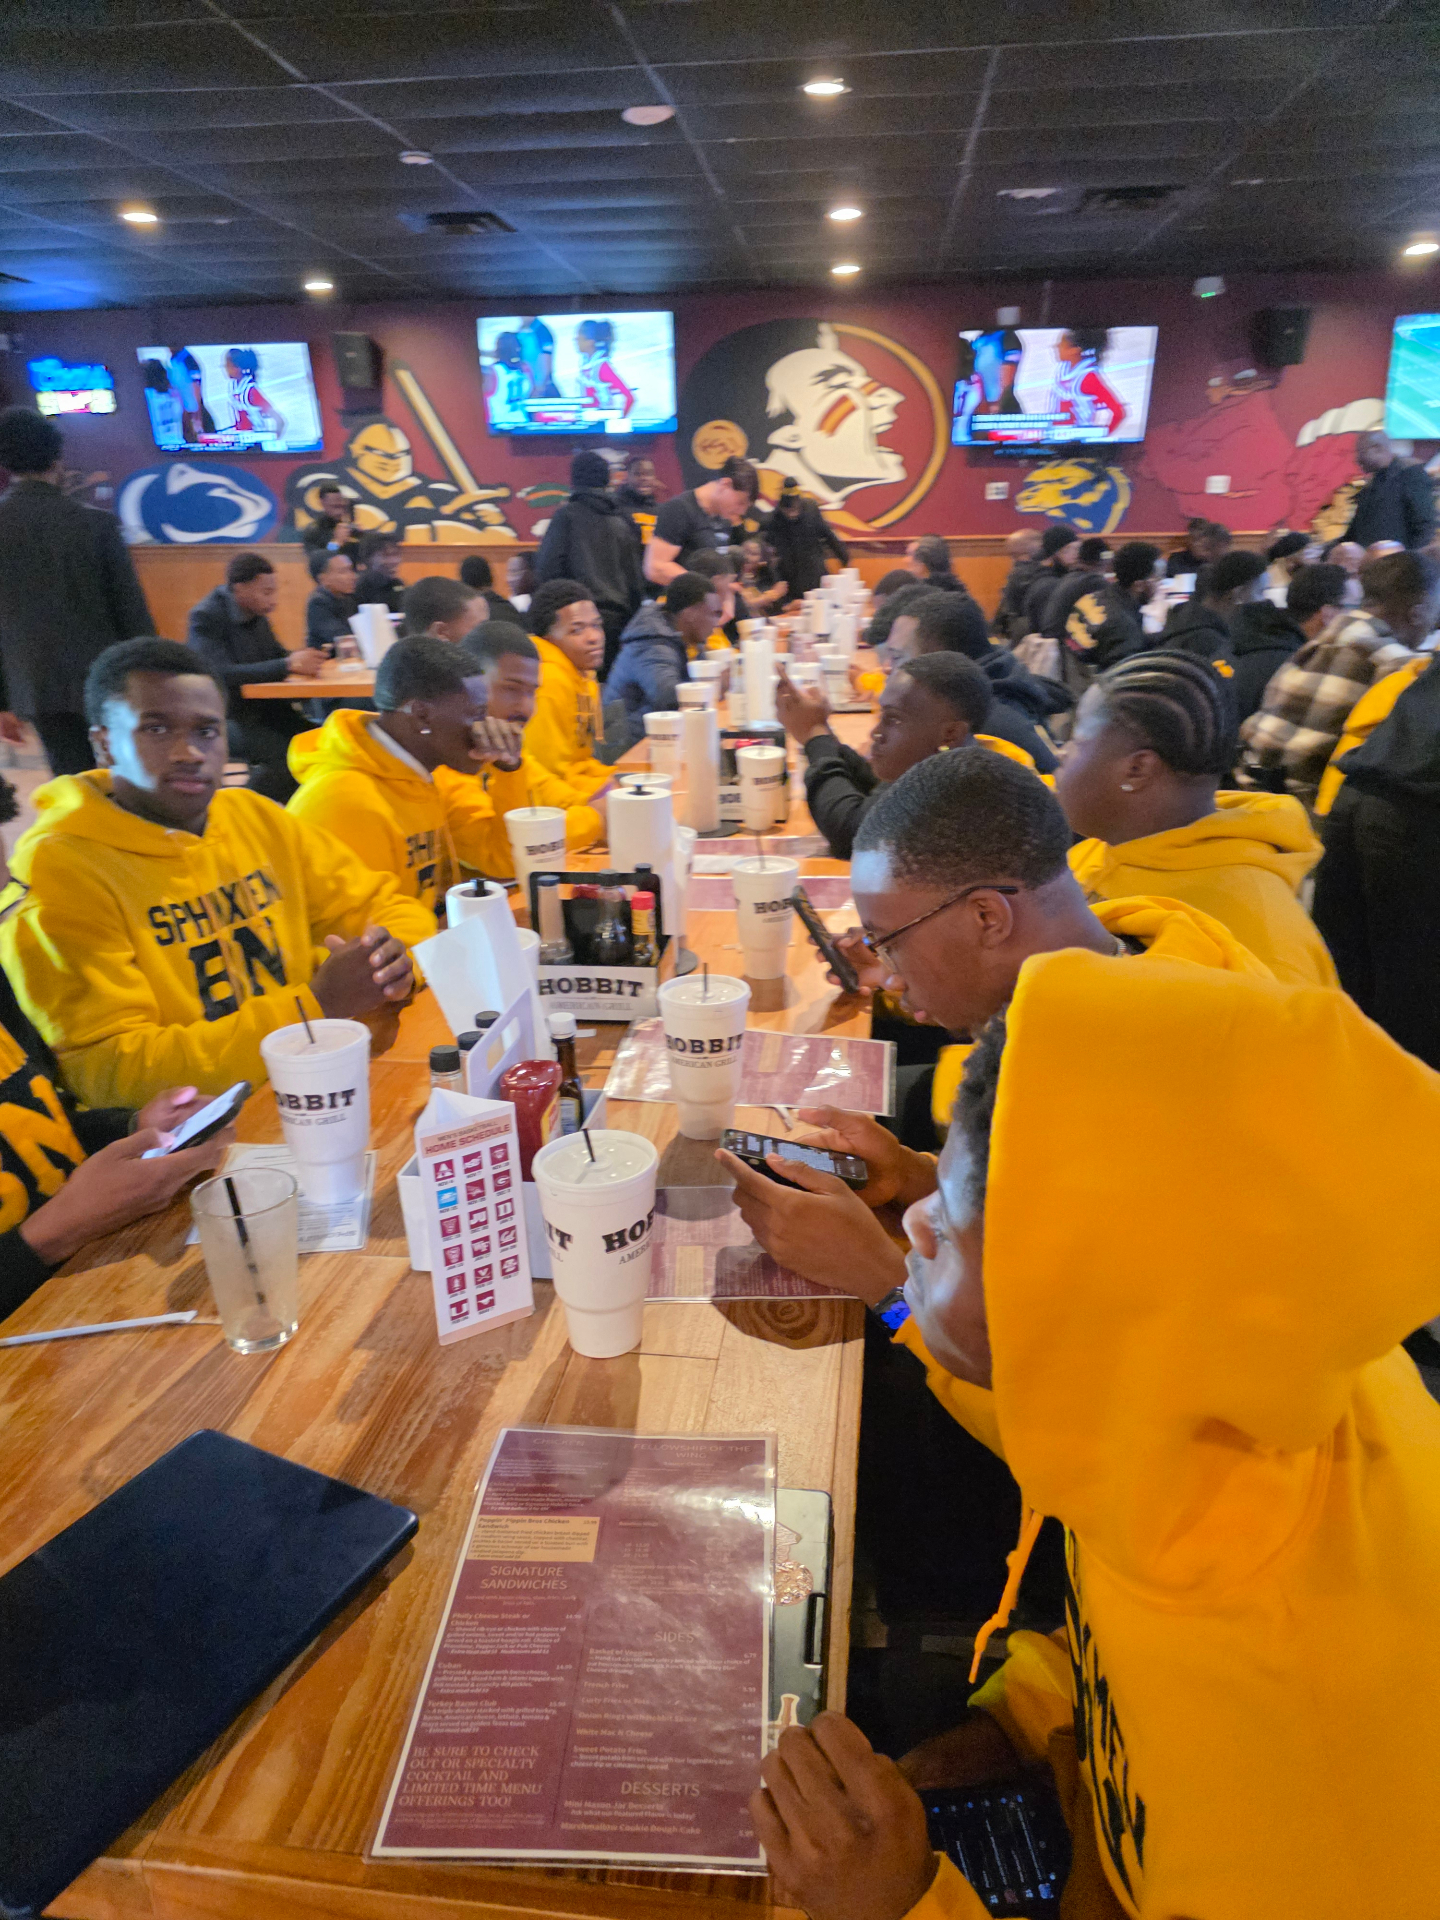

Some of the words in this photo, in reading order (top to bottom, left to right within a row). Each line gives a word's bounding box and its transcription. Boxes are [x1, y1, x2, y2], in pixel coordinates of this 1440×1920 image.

[538, 977, 644, 997] HOBBIT
[274, 1088, 356, 1110] OBBIT
[458, 1121, 498, 1137] BASKETBALL
[425, 1140, 457, 1154] HOME
[459, 1123, 510, 1146] SCHEDULE
[490, 1566, 564, 1576] SIGNATURE
[480, 1579, 568, 1590] SANDWICHES
[654, 1631, 695, 1643] SIDES
[414, 1746, 429, 1757] BE
[433, 1746, 468, 1757] SURE
[474, 1746, 490, 1756] TO
[494, 1746, 540, 1757] CHECK
[410, 1758, 439, 1769] OUT
[441, 1758, 461, 1769] OR
[464, 1758, 536, 1769] SPECIALTY
[407, 1771, 474, 1781] COCKTAIL
[479, 1770, 509, 1780] AND
[402, 1783, 460, 1793] LIMITED
[463, 1783, 498, 1793] TIME
[500, 1783, 543, 1794] MENU
[621, 1781, 700, 1797] DESSERTS
[399, 1795, 475, 1806] OFFERINGS
[479, 1795, 512, 1807] TOO!
[561, 1822, 618, 1831] Marshmallow
[619, 1824, 648, 1832] Cookie
[650, 1825, 678, 1833] Dough
